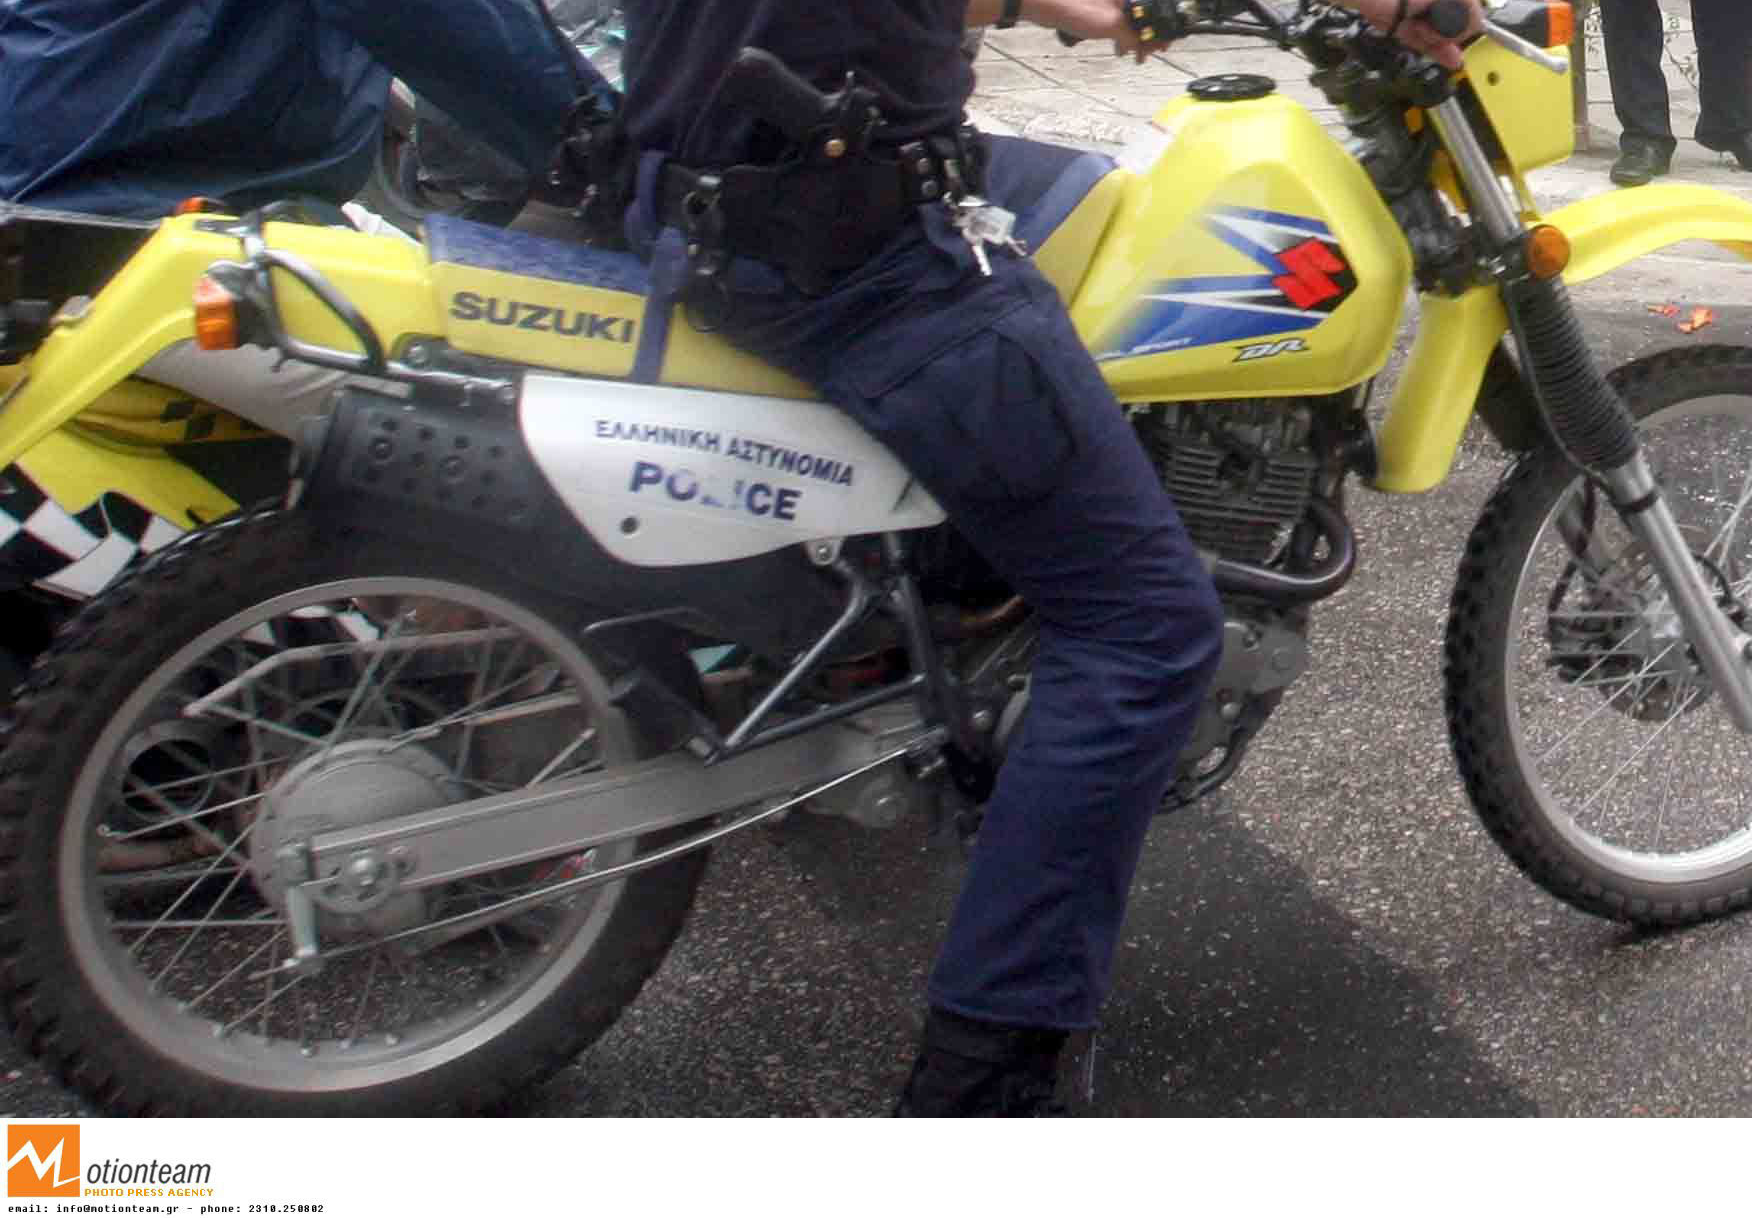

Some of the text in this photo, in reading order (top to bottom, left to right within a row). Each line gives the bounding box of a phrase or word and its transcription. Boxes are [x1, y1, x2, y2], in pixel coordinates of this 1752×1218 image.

[451, 291, 636, 343] SUZUKI
[595, 418, 856, 488] ΕΛΛΗΝΙΚΗ ΑΣΤΥΝΟΜΙΑ
